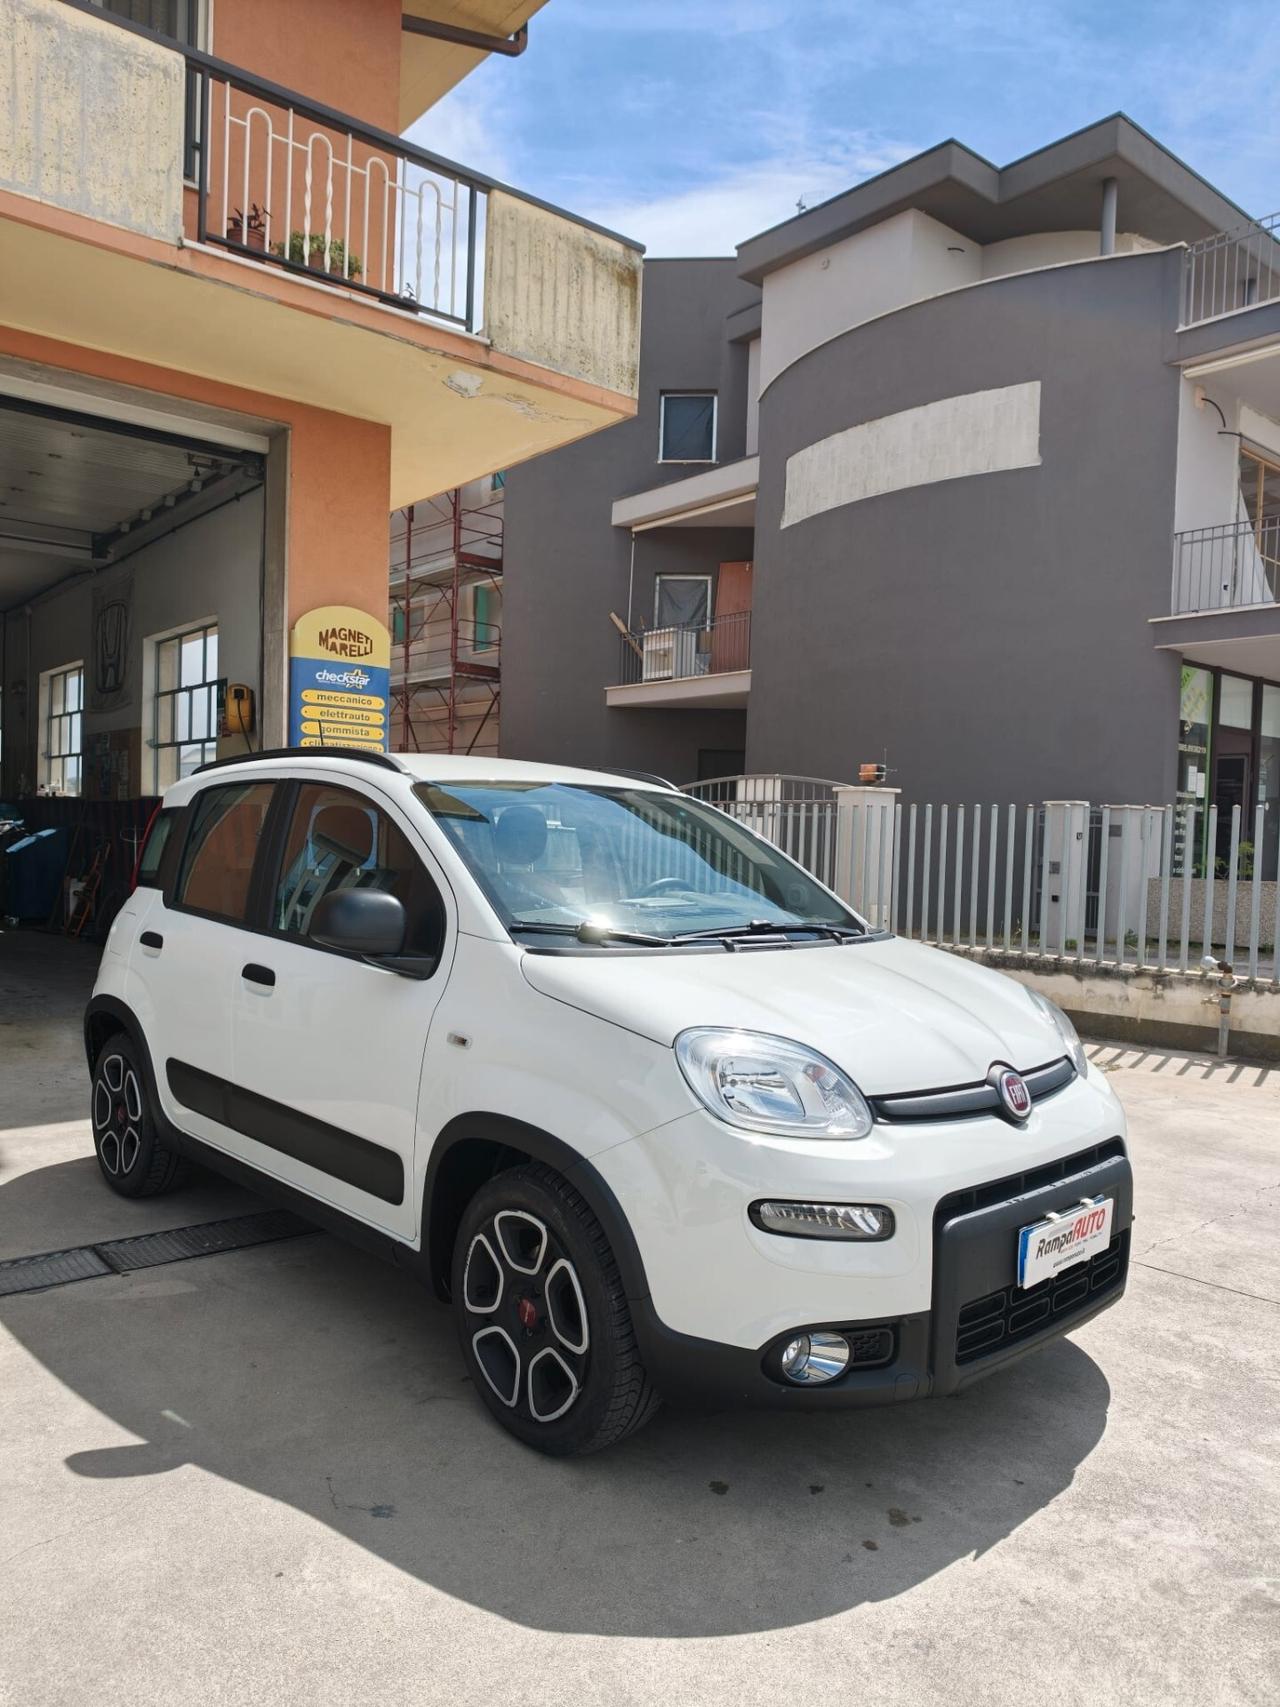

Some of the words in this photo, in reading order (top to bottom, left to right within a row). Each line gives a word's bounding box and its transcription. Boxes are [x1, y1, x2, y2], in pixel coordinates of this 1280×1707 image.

[318, 627, 373, 654] MAGNETI
[318, 629, 373, 657] MARELLI
[315, 669, 370, 686] checkstar
[316, 694, 372, 705] meccanico
[320, 709, 370, 721] elettrauto
[1008, 1083, 1027, 1105] FIAT
